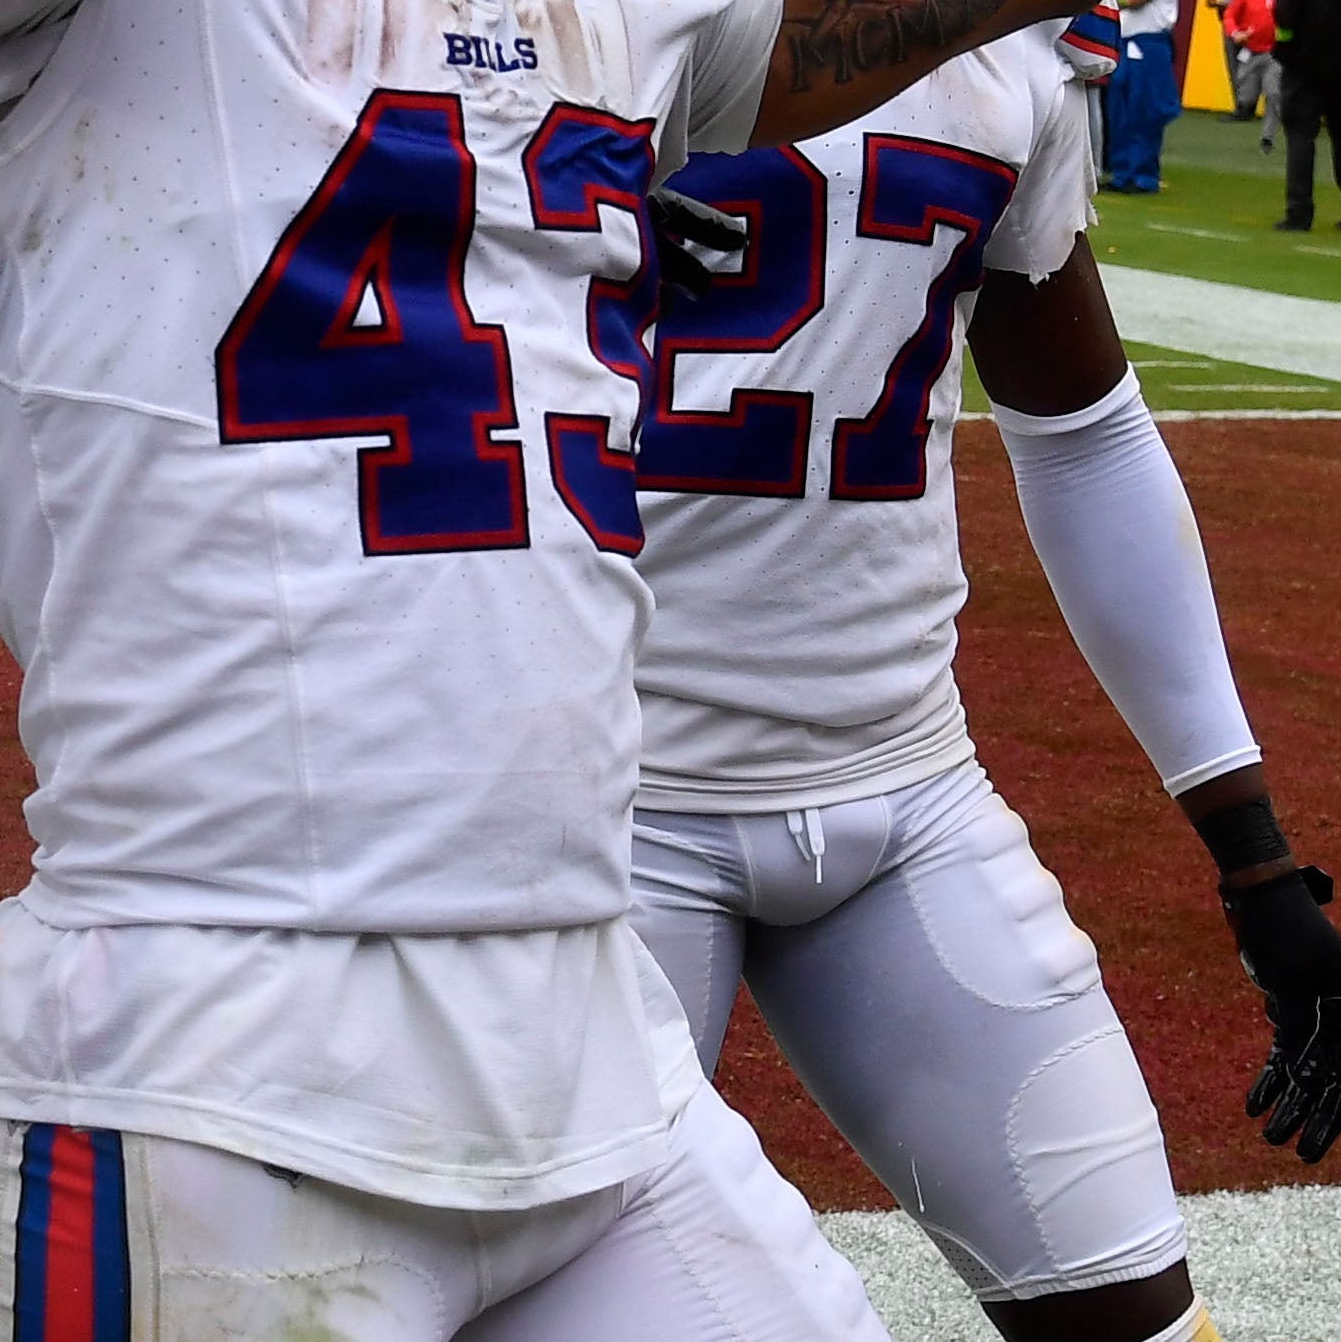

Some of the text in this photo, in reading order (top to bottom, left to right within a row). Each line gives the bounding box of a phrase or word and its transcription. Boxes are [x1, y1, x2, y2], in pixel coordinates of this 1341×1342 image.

[443, 32, 538, 73] BILLS
[214, 86, 656, 558] 43
[635, 133, 1019, 501] 27
